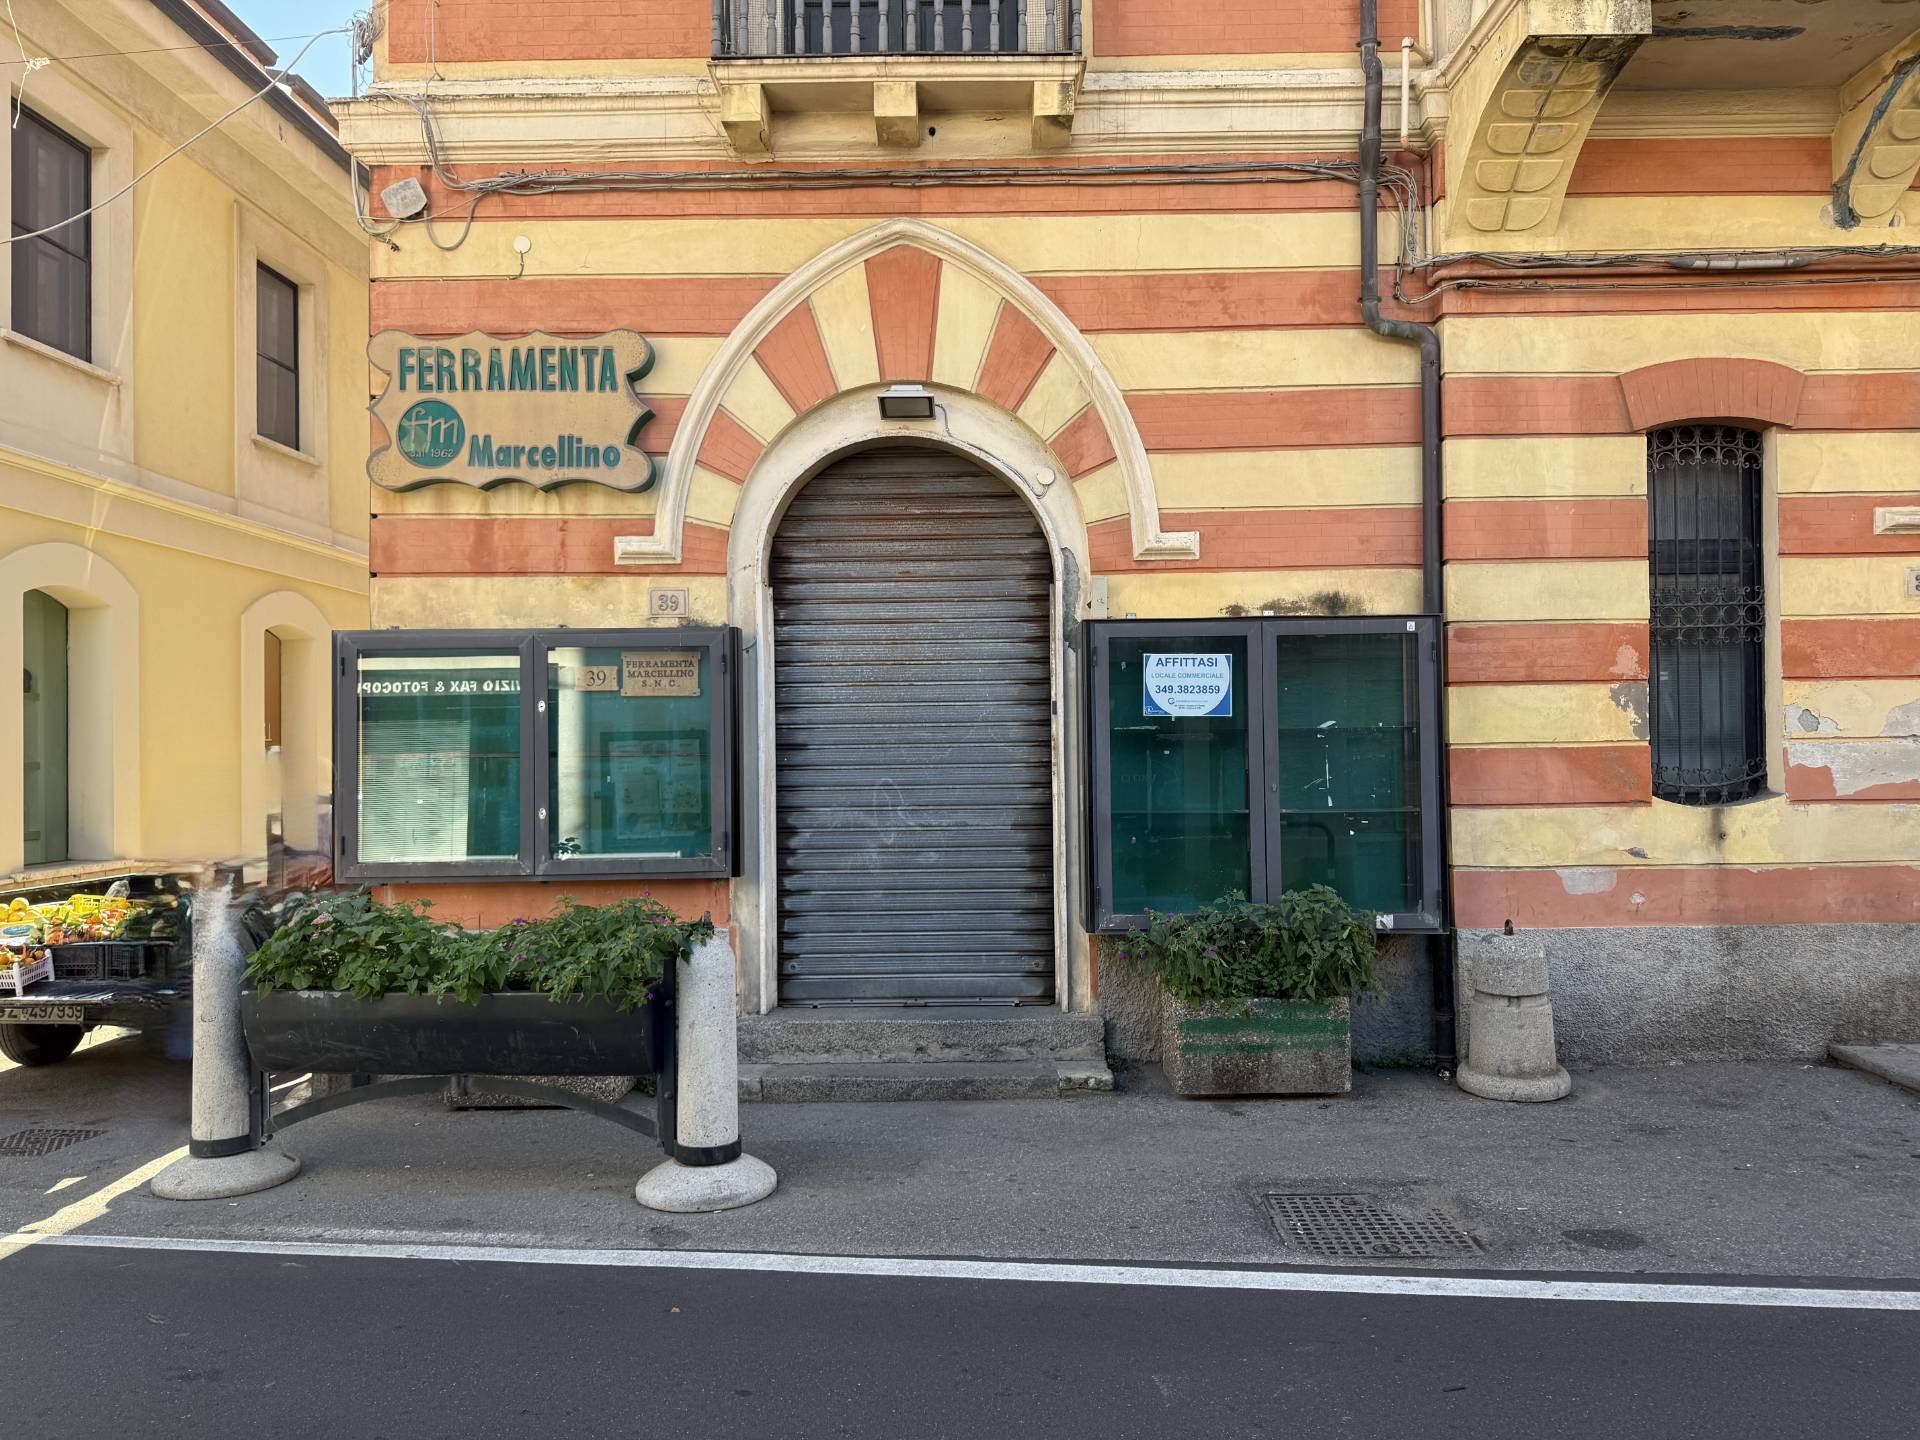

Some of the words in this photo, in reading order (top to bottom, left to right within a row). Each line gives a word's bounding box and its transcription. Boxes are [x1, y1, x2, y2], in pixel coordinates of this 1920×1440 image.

[399, 346, 618, 392] FERRAMENTA
[431, 448, 454, 458] 1962
[468, 434, 620, 468] Marcellino
[658, 594, 680, 611] 39
[625, 660, 695, 669] FERRAMENTA
[1156, 657, 1218, 667] AFFITTASI
[585, 670, 607, 686] 39
[627, 669, 695, 678] MARCELLINO
[1155, 684, 1220, 694] 349.3823859
